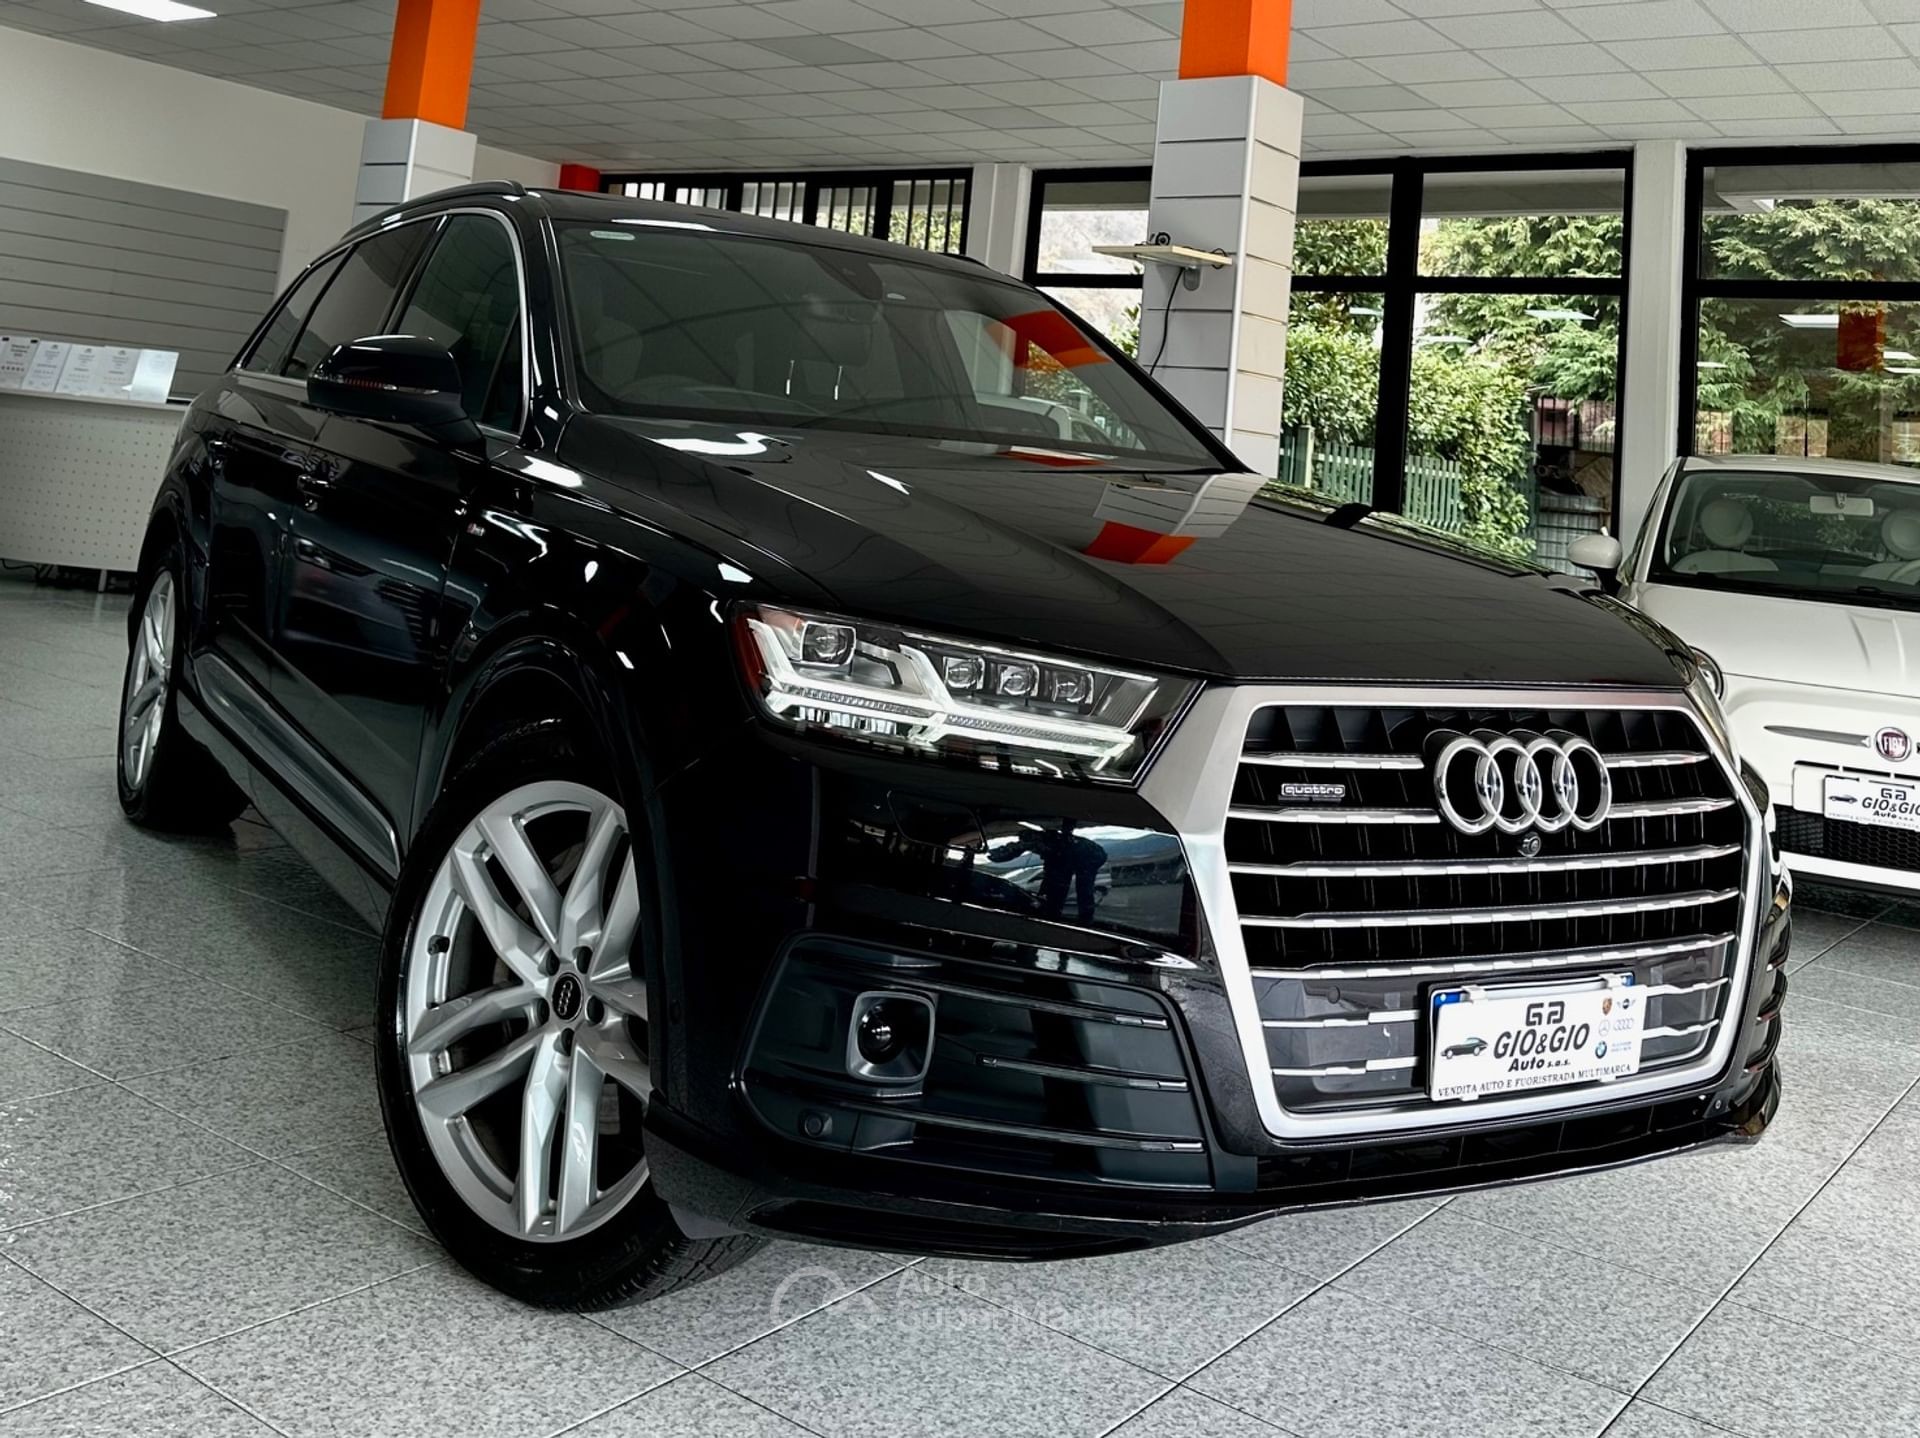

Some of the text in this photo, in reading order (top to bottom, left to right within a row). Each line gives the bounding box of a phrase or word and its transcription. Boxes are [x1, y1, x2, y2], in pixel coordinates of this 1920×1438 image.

[1882, 735, 1906, 757] FIAT
[1285, 786, 1343, 796] quattro
[1493, 1023, 1590, 1060] GIO&GIO
[1508, 1057, 1545, 1072] Auto
[1438, 1084, 1477, 1097] VENDITA
[1480, 1080, 1505, 1092] AUTO
[1515, 1071, 1575, 1087] FUORISTRADA
[1578, 1063, 1631, 1079] MULTIMARCA
